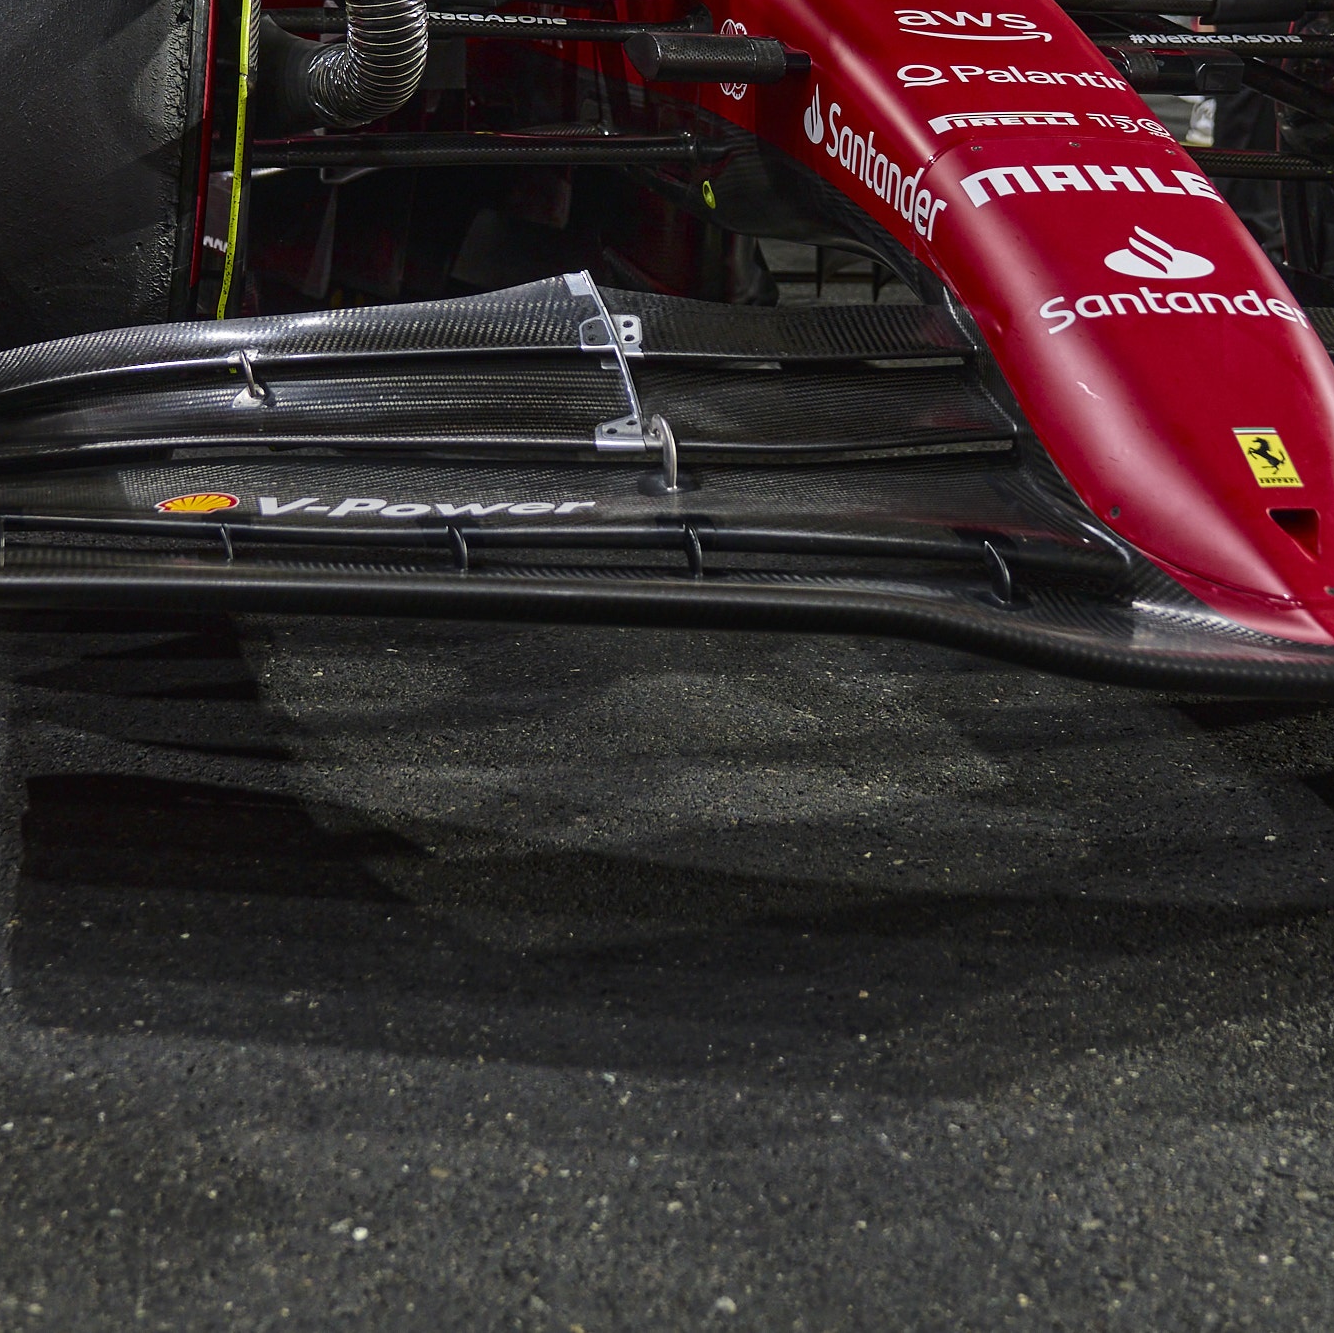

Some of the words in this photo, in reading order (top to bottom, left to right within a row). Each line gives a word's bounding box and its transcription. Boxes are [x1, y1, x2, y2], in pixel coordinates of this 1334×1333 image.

[894, 9, 1037, 30] aws
[1129, 33, 1303, 44] #WeRaceAsOne
[949, 65, 1127, 92] Palantir
[928, 111, 1080, 135] PIRELLI
[1086, 112, 1171, 137] 150
[826, 102, 948, 241] Santander
[960, 165, 1224, 208] MAHLE
[1039, 286, 1309, 335] Santander
[259, 496, 597, 517] V-Power
